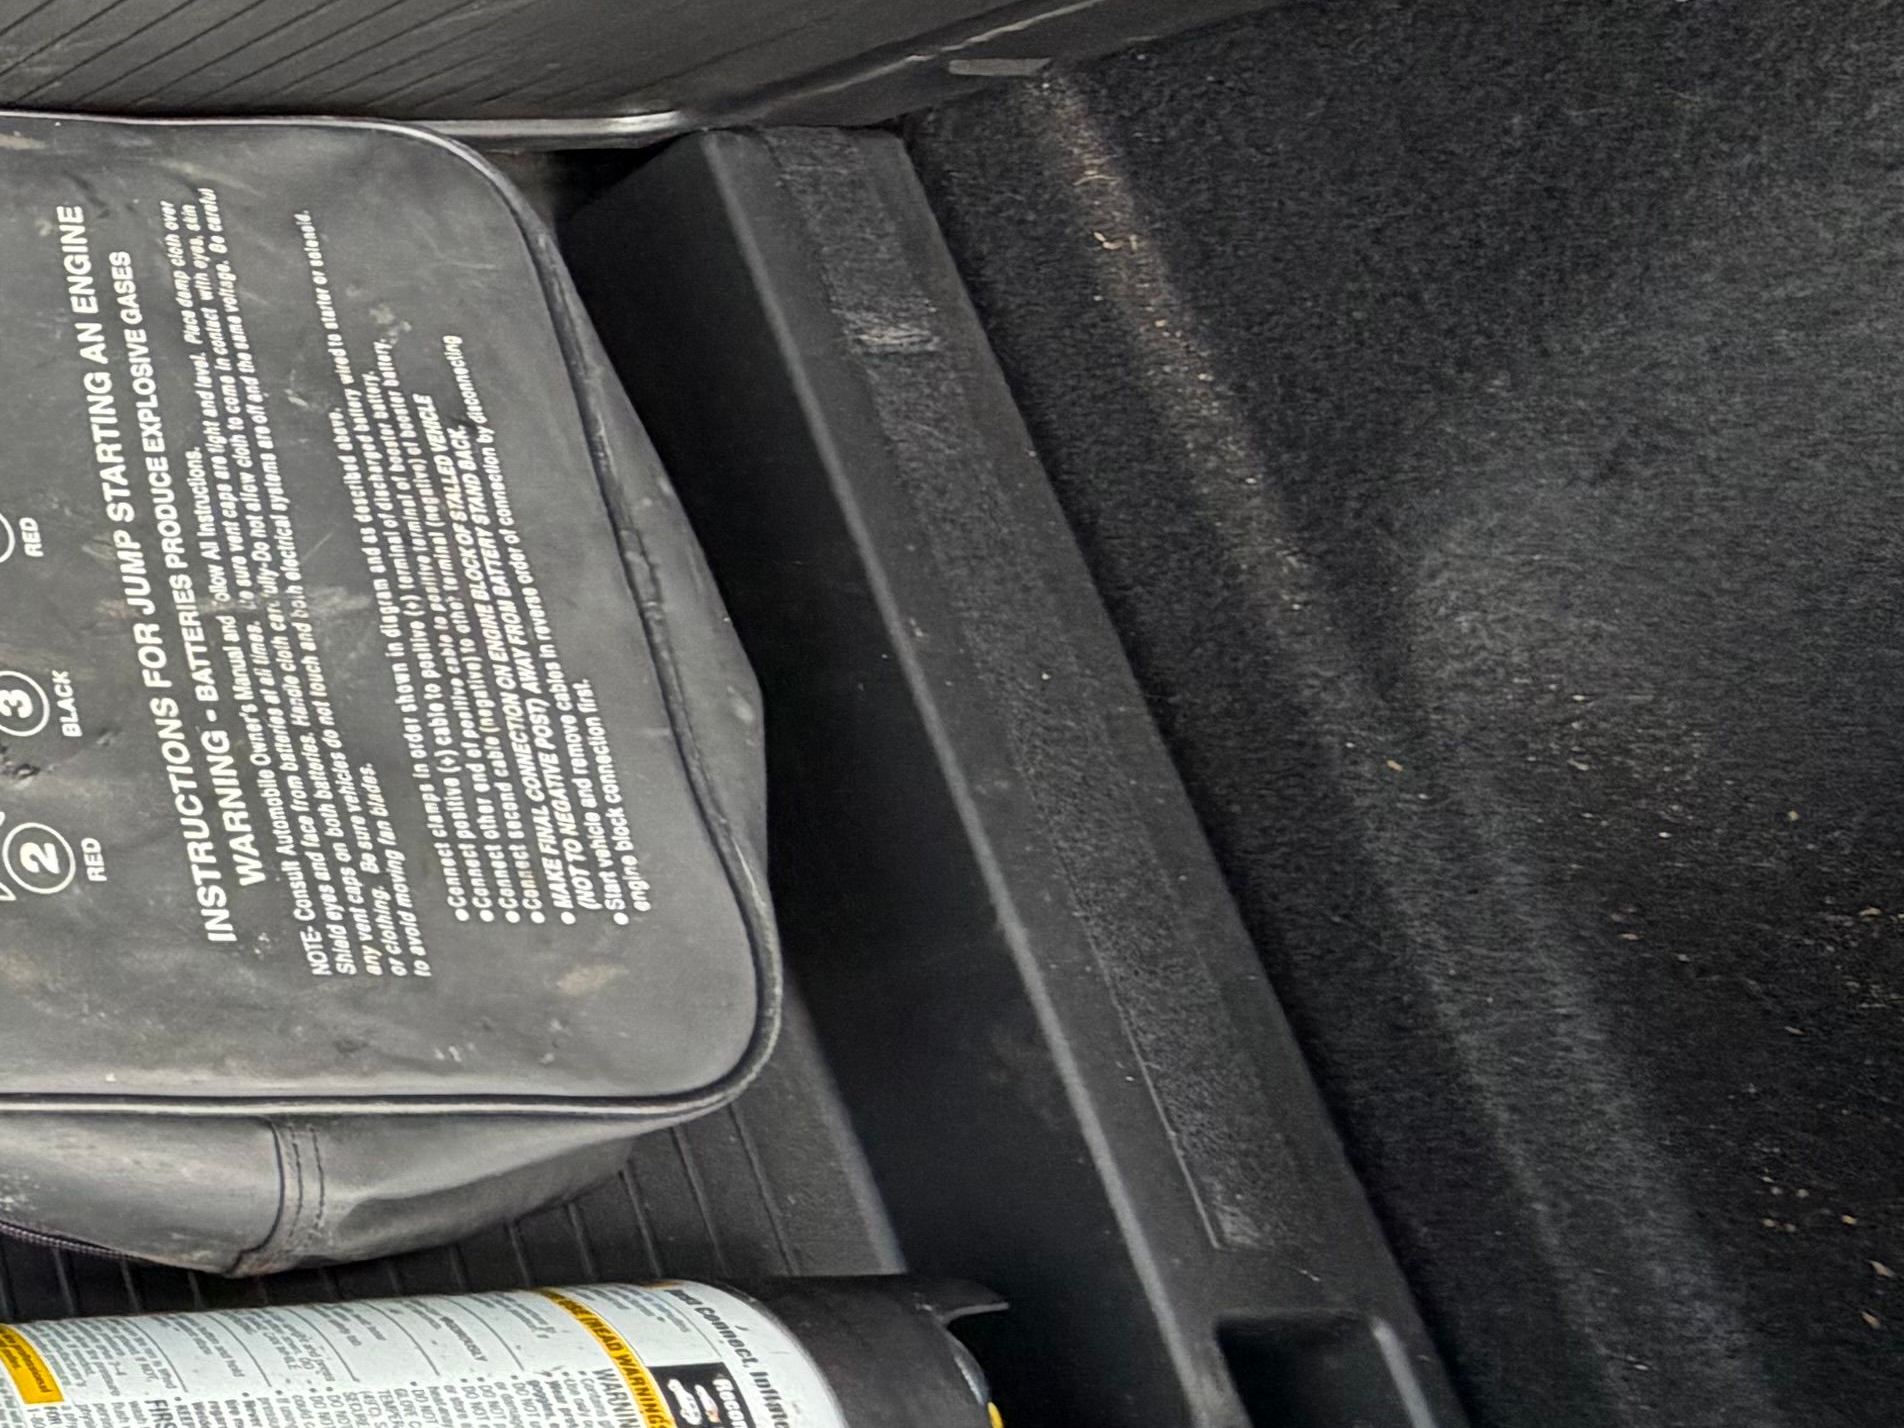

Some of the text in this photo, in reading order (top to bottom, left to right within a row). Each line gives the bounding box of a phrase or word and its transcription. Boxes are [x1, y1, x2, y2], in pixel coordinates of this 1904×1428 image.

[107, 250, 143, 325] GASES
[122, 328, 166, 452] EXPLOSIVE
[143, 455, 189, 569] PRODUCE
[184, 445, 217, 537] Instructions.
[17, 516, 44, 557] RED
[55, 205, 238, 942] INSTRUCTIONS FOR JUMP STARTING AN ENGINE
[198, 540, 222, 561] All
[167, 572, 219, 702] BATTERIES
[214, 614, 241, 643] and
[411, 392, 574, 909] MAKE FINAL CONNECTION ON ENGINE BLOCK OF STALLED VEHICLE
[441, 334, 626, 911] Start vehicle and remove cables in reverse order of connection by disconnecting
[50, 669, 83, 737] BLACK
[221, 645, 254, 700] Manual
[445, 424, 603, 910] (NOT TO NEGATIVE POST) AWAY FROM BATTERY STAND BACK.
[237, 702, 272, 767] Owner's
[199, 729, 267, 886] WARNING
[255, 768, 297, 856] Automobile
[571, 677, 652, 909] engine block connection first.
[18, 841, 60, 874] 2
[79, 836, 108, 882] RED
[279, 859, 316, 921] Consult
[358, 762, 432, 977] to avoid moving fan blades.
[173, 1403, 196, 1428] KEEP
